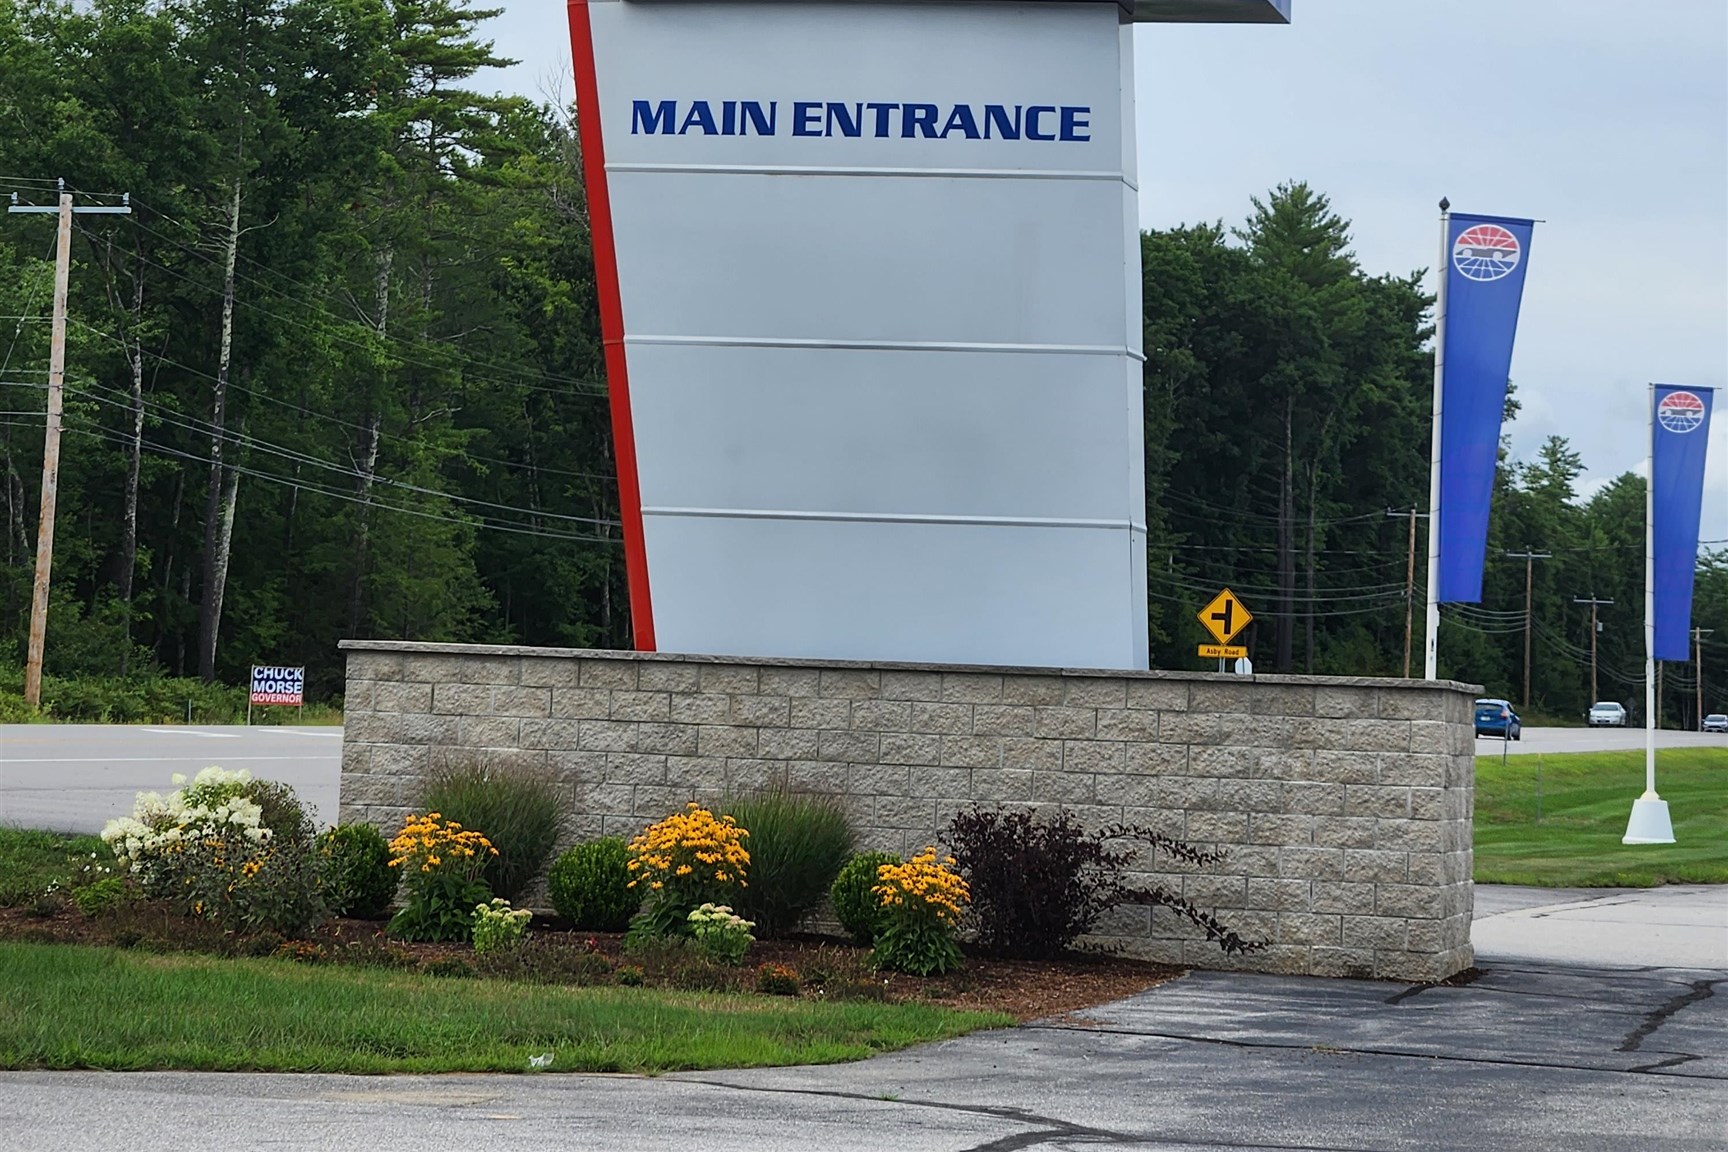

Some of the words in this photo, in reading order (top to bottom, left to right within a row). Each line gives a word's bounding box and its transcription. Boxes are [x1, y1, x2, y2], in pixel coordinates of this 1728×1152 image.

[630, 100, 777, 136] MAIN
[792, 101, 1091, 142] ENTRANCE
[1206, 647, 1221, 656] Asby
[253, 667, 303, 680] CHUCK
[253, 680, 302, 694] MORSE
[251, 693, 302, 703] GOVERNOR
